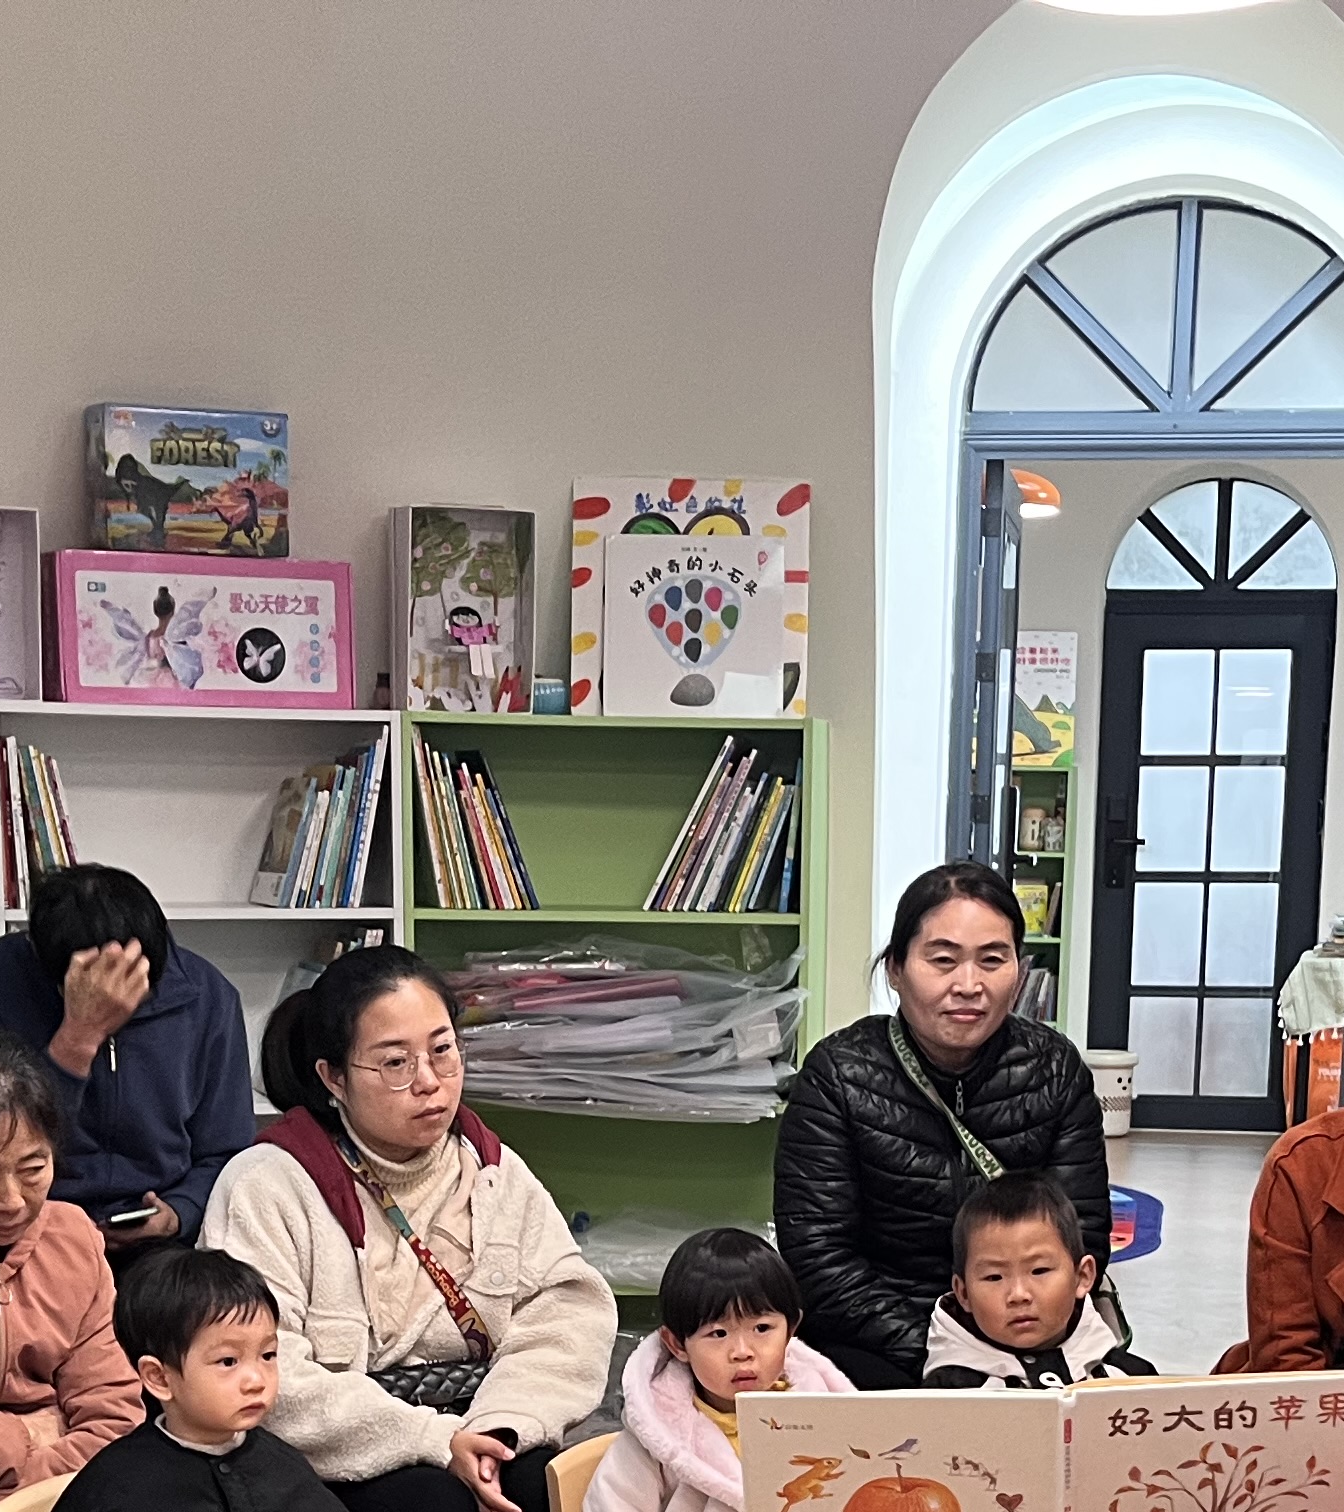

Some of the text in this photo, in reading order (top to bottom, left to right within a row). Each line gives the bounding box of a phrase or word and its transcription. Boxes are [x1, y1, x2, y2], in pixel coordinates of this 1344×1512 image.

[150, 438, 240, 467] FOREST
[629, 555, 758, 598] 好神奇的小石头
